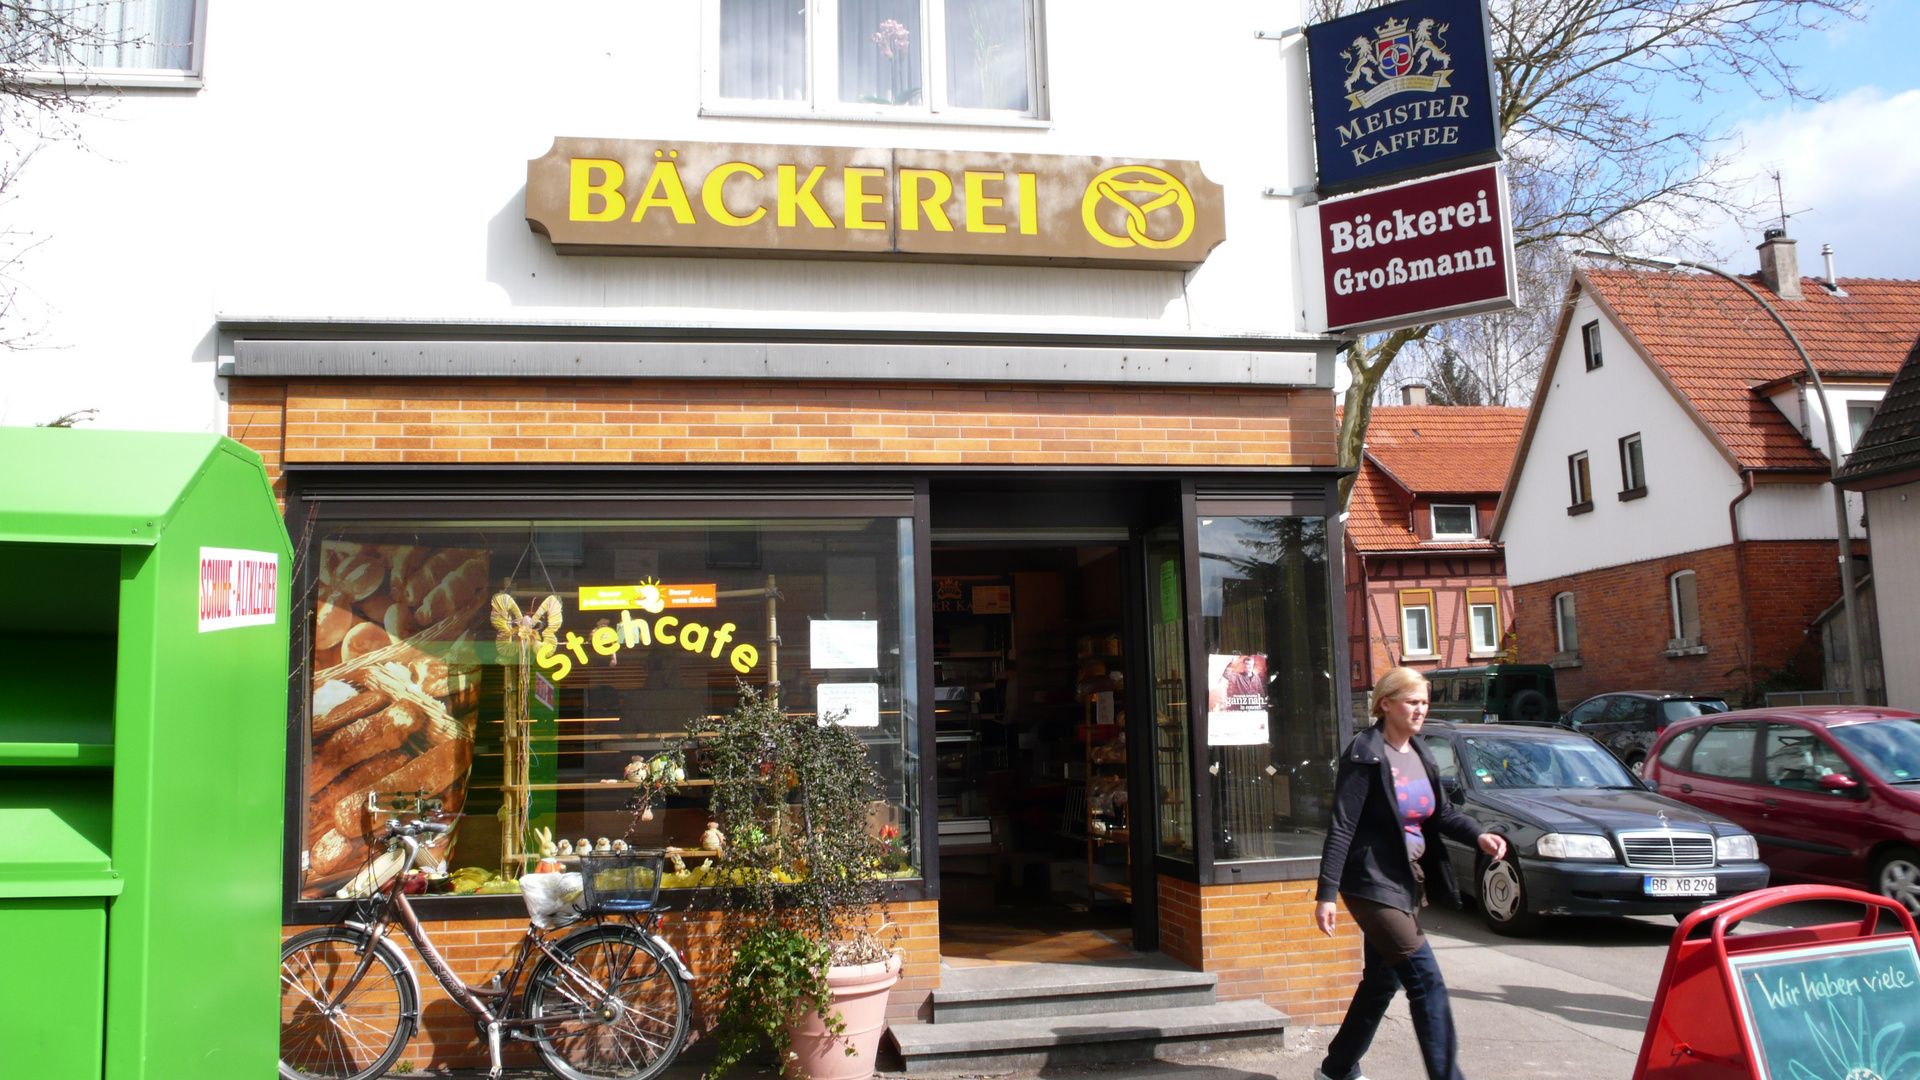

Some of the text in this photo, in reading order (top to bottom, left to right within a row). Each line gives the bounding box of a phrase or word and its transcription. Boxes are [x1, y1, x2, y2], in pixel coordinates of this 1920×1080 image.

[1336, 95, 1469, 147] MEISTER
[1351, 126, 1458, 166] KAFFEE
[569, 149, 1038, 235] BÄCKEREI
[1329, 189, 1492, 254] Bäckerei
[1333, 246, 1496, 296] Großmann
[536, 609, 759, 681] Stehcafe
[1652, 879, 1715, 891] BB XB 296
[1754, 966, 1914, 1009] Wir haben viele
